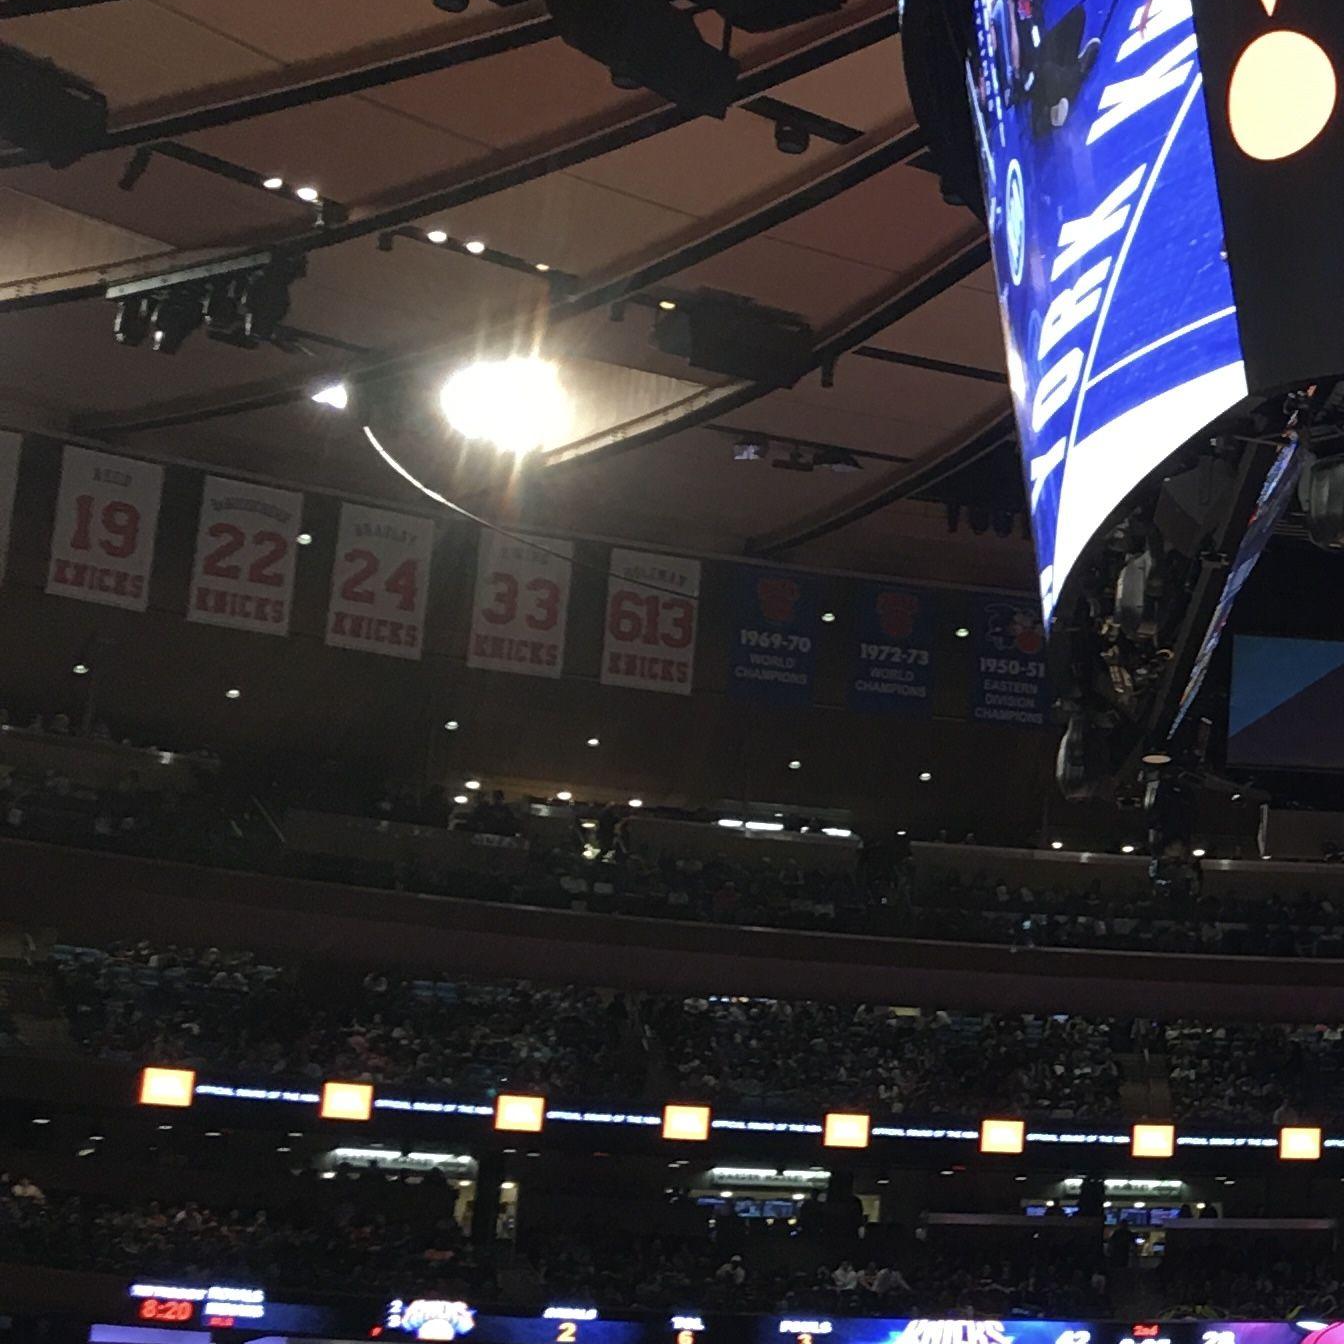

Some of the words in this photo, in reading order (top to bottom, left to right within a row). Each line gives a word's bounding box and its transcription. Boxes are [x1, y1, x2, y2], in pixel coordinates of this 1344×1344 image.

[70, 495, 140, 558] 19
[202, 522, 288, 587] 22
[54, 558, 143, 598] KNICKS
[341, 548, 421, 612] 24
[195, 587, 284, 623] KNICKS
[482, 572, 560, 631] 33
[331, 612, 418, 647] KNICKS
[608, 589, 695, 649] 613
[473, 633, 559, 667] KNICKS
[740, 629, 812, 653] 1969-70
[860, 641, 930, 667] 1972-73
[607, 652, 691, 684] KNICKS
[734, 666, 808, 686] CHAMPIONS
[749, 653, 796, 670] WORLD
[870, 666, 915, 682] WORLD
[979, 656, 1046, 678] 1950-51
[854, 679, 927, 699] CHAMPIONS
[983, 679, 1039, 696] EASTERN
[974, 705, 1044, 724] CHAMPIONS
[557, 1322, 576, 1343] 2
